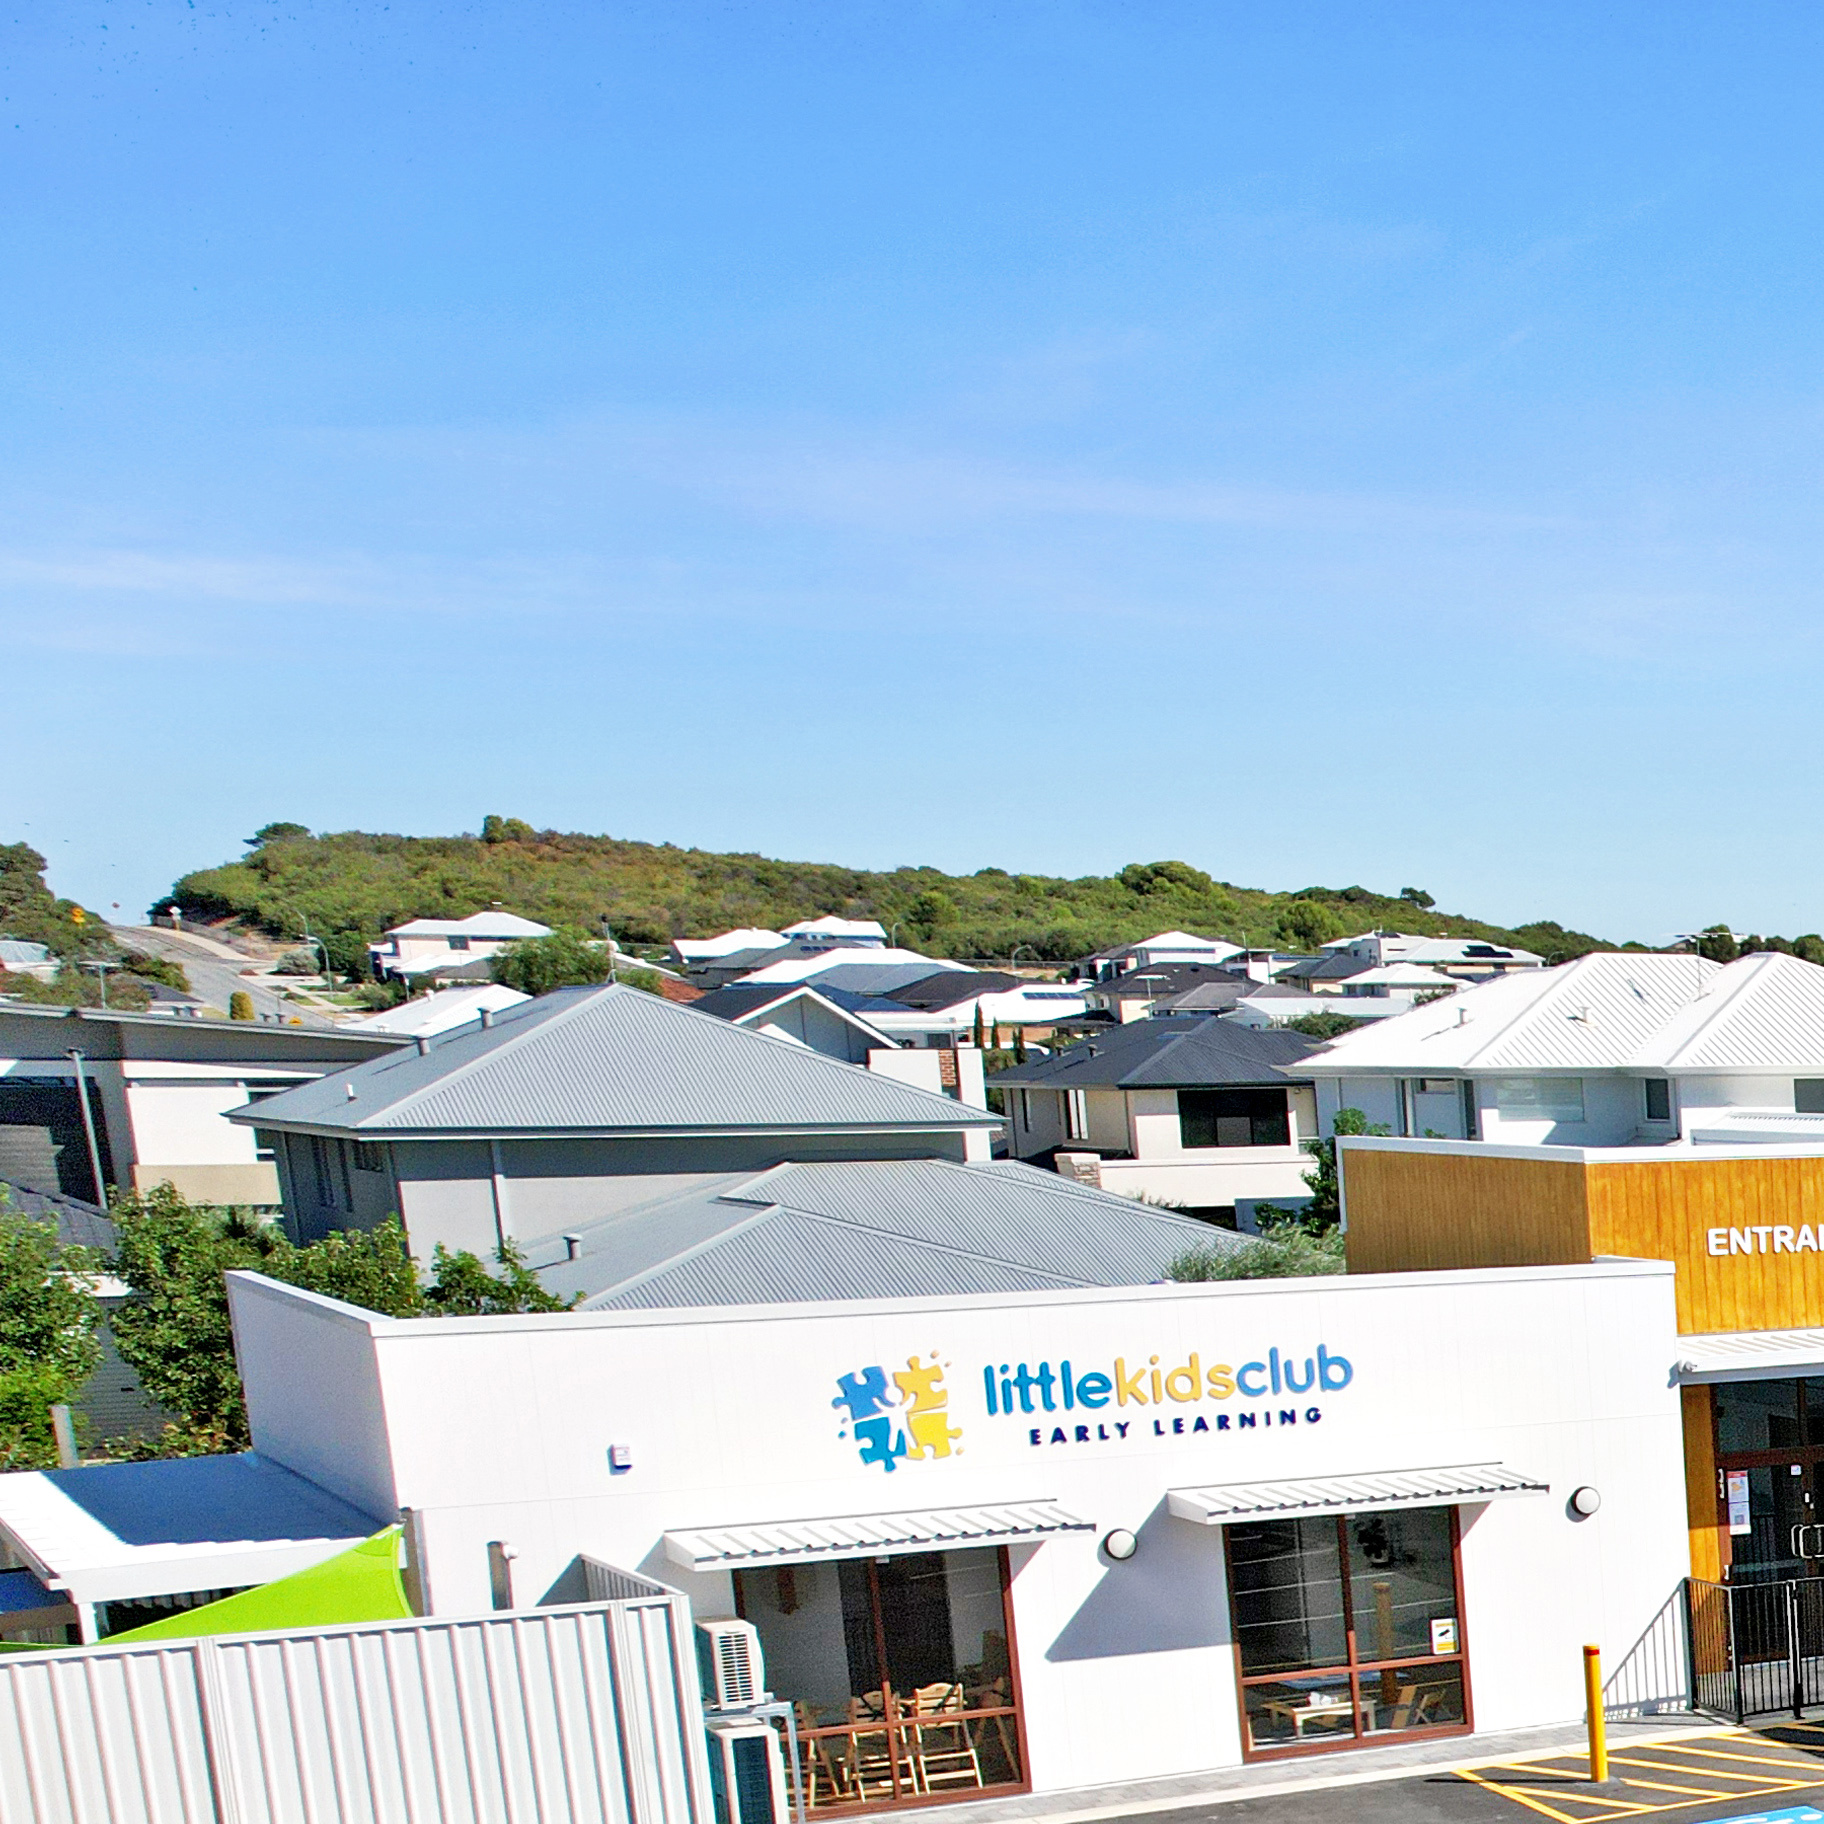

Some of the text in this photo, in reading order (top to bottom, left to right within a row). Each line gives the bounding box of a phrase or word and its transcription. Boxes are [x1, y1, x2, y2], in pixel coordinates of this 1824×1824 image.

[983, 1343, 1353, 1416] littlekidsclub
[1029, 1407, 1322, 1446] EARLY LEARNING
